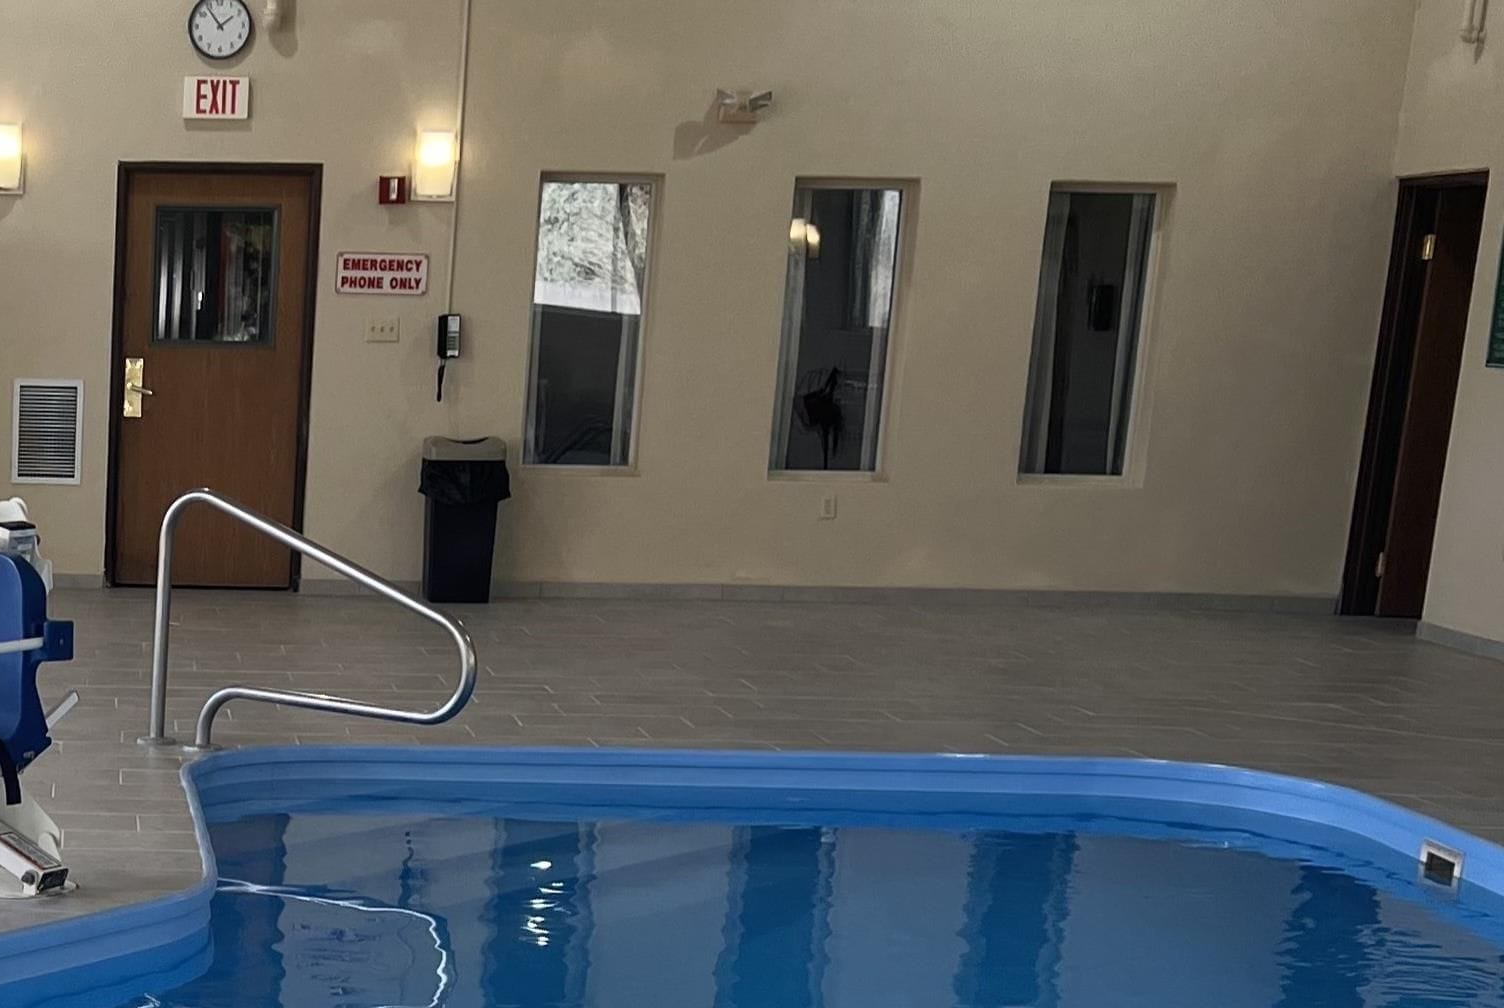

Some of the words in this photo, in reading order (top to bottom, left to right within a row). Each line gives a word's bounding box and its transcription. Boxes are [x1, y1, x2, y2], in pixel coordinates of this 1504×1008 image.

[196, 79, 240, 115] EXIT
[343, 258, 422, 272] EMERGENCY
[341, 276, 384, 289] PHONE
[389, 277, 422, 290] ONLY
